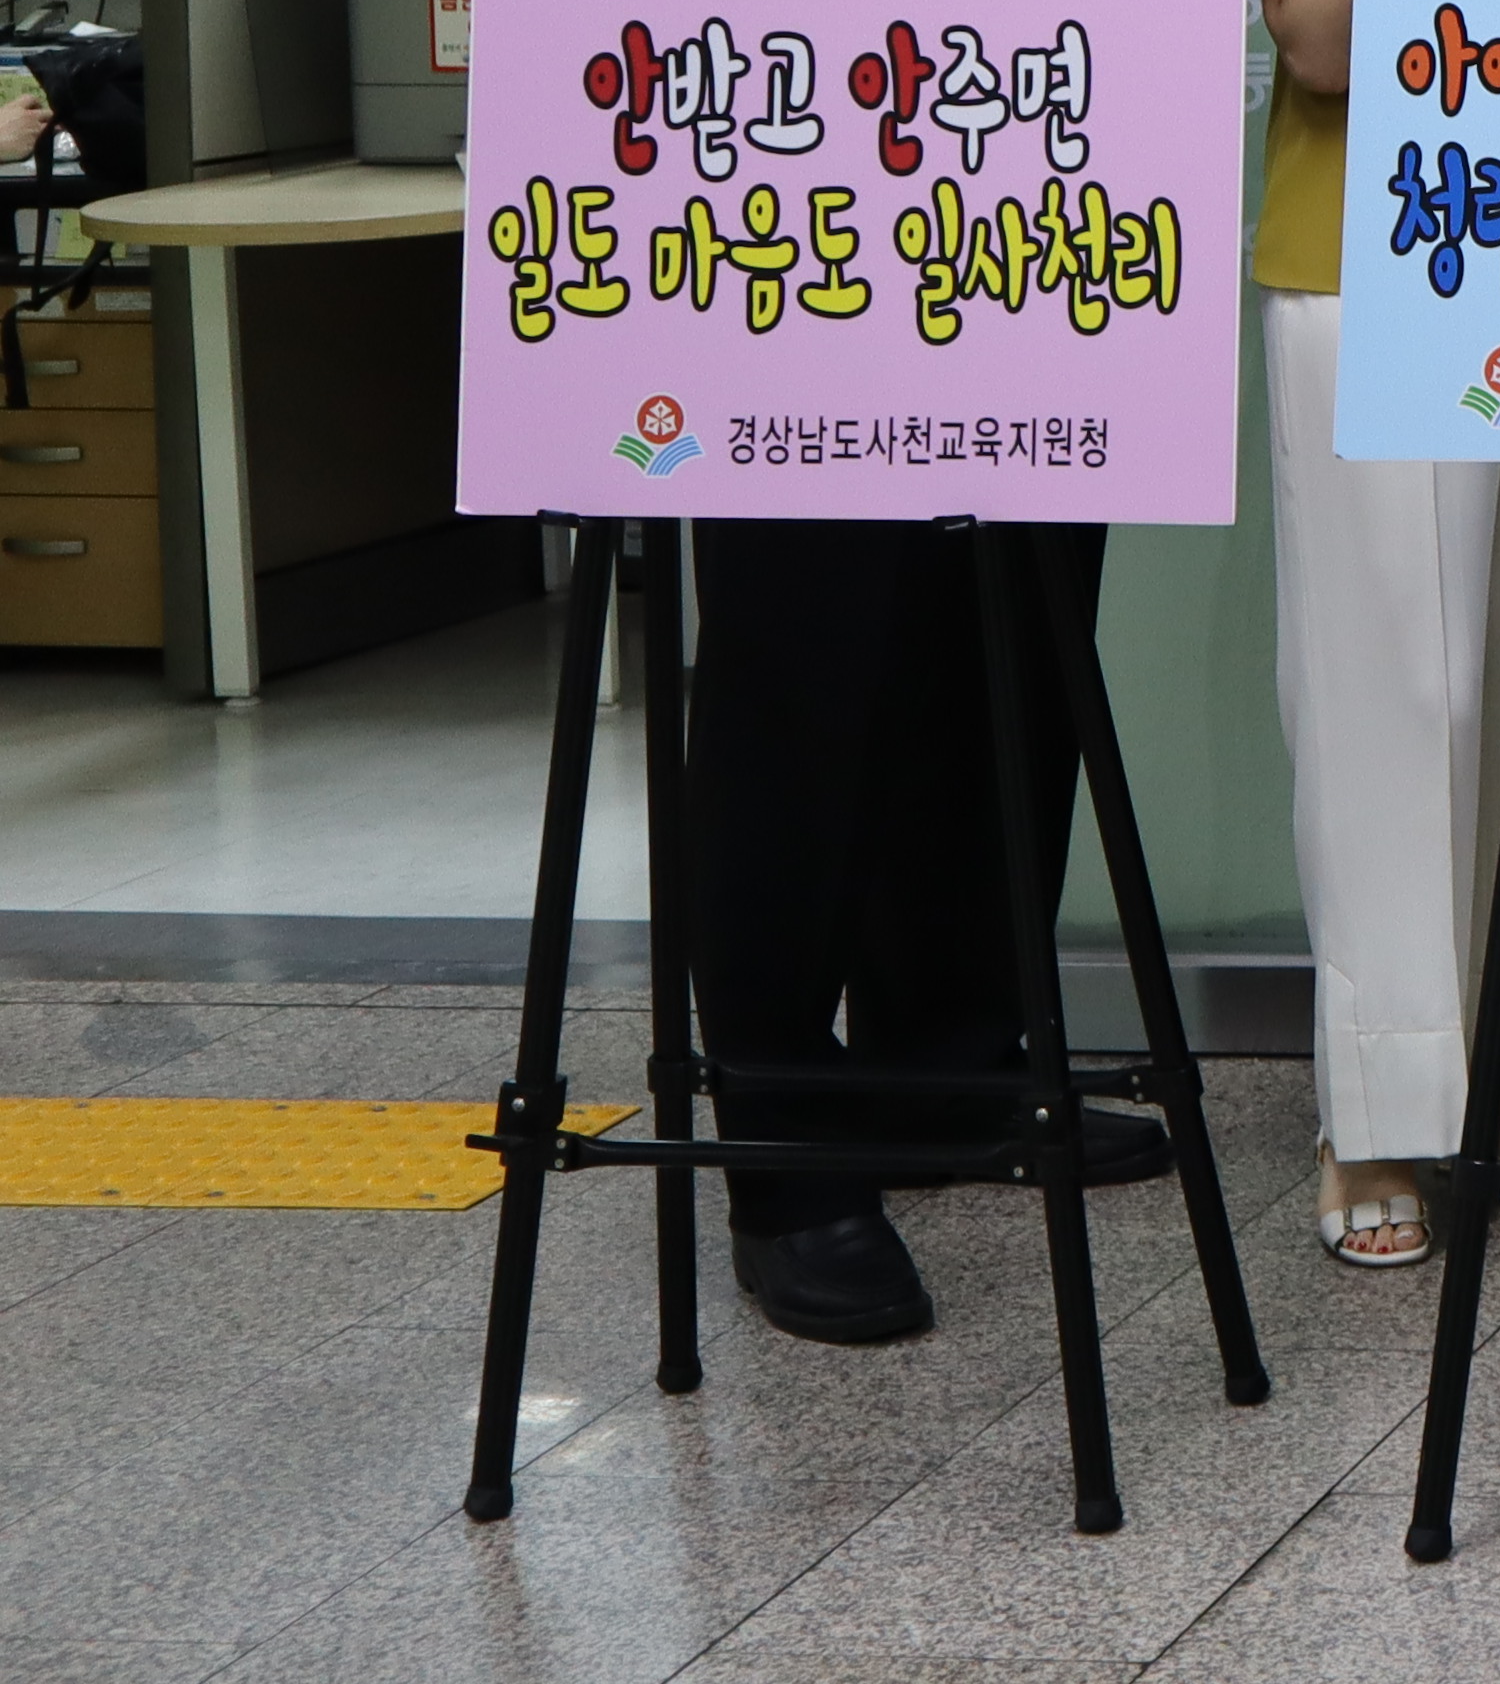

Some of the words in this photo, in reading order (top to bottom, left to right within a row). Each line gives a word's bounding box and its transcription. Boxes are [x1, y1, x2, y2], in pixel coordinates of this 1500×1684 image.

[583, 17, 824, 182] 안받고
[848, 19, 1092, 176] 안주면
[488, 175, 630, 343] 일도
[649, 182, 871, 335] 마음도
[893, 176, 1182, 345] 일사천리
[727, 413, 1110, 469] 경상남도사천교육지원청
